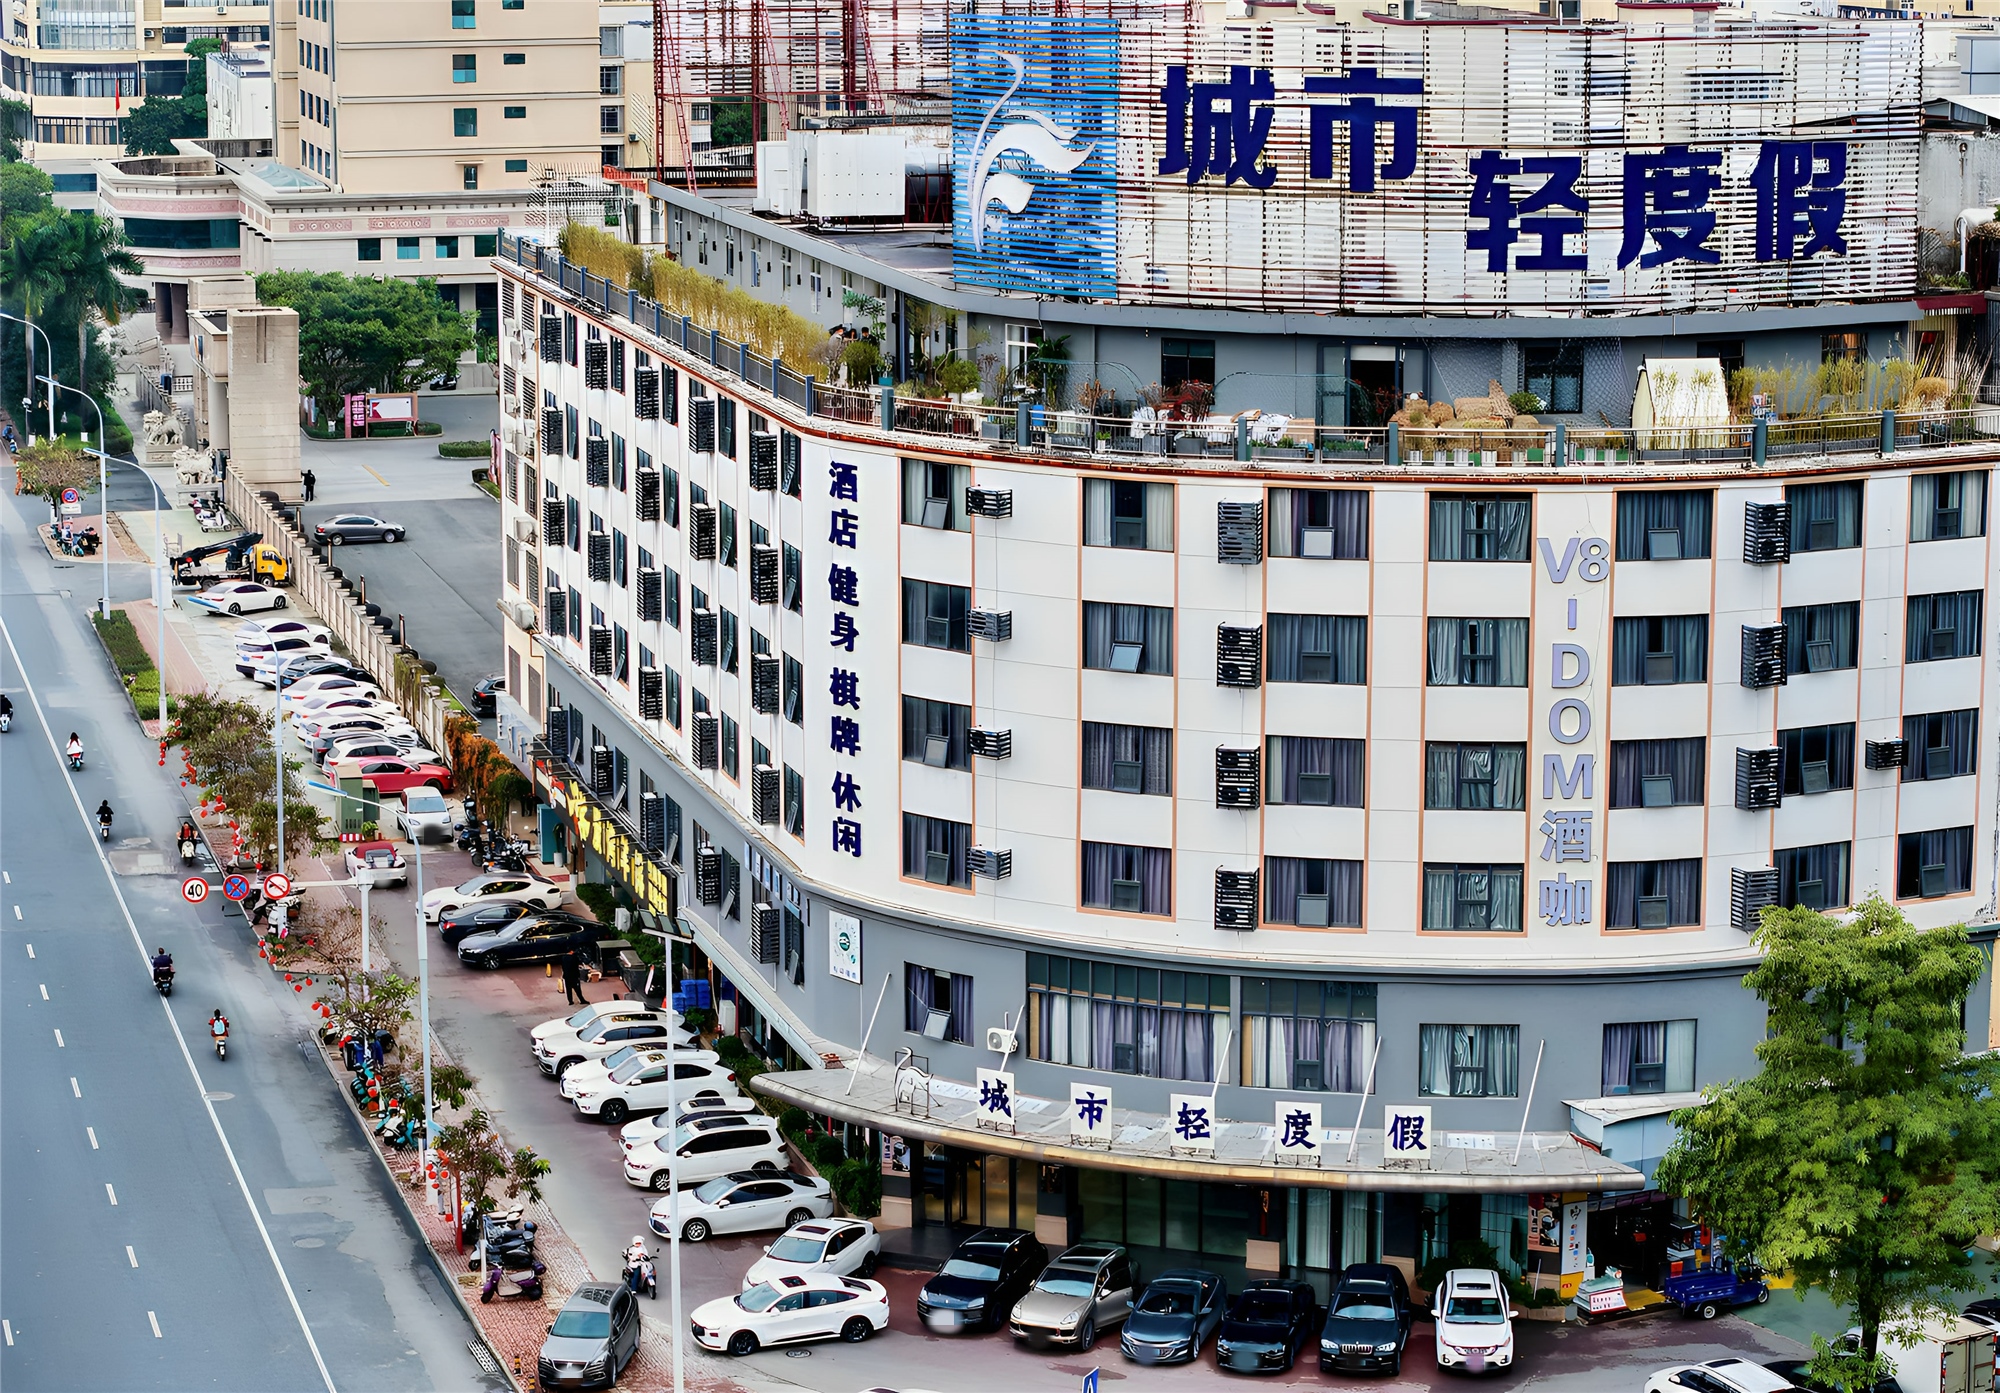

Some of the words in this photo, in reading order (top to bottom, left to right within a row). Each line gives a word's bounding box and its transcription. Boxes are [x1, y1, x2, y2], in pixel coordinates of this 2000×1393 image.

[1159, 65, 1425, 193] 城市
[1466, 140, 1848, 273] 轻度假
[828, 460, 859, 549] 酒店
[827, 563, 860, 652] 健身
[829, 667, 862, 756] 棋牌
[831, 770, 862, 858] 休闲
[187, 883, 203, 898] 40
[978, 1077, 1429, 1151] 城市轻度假
